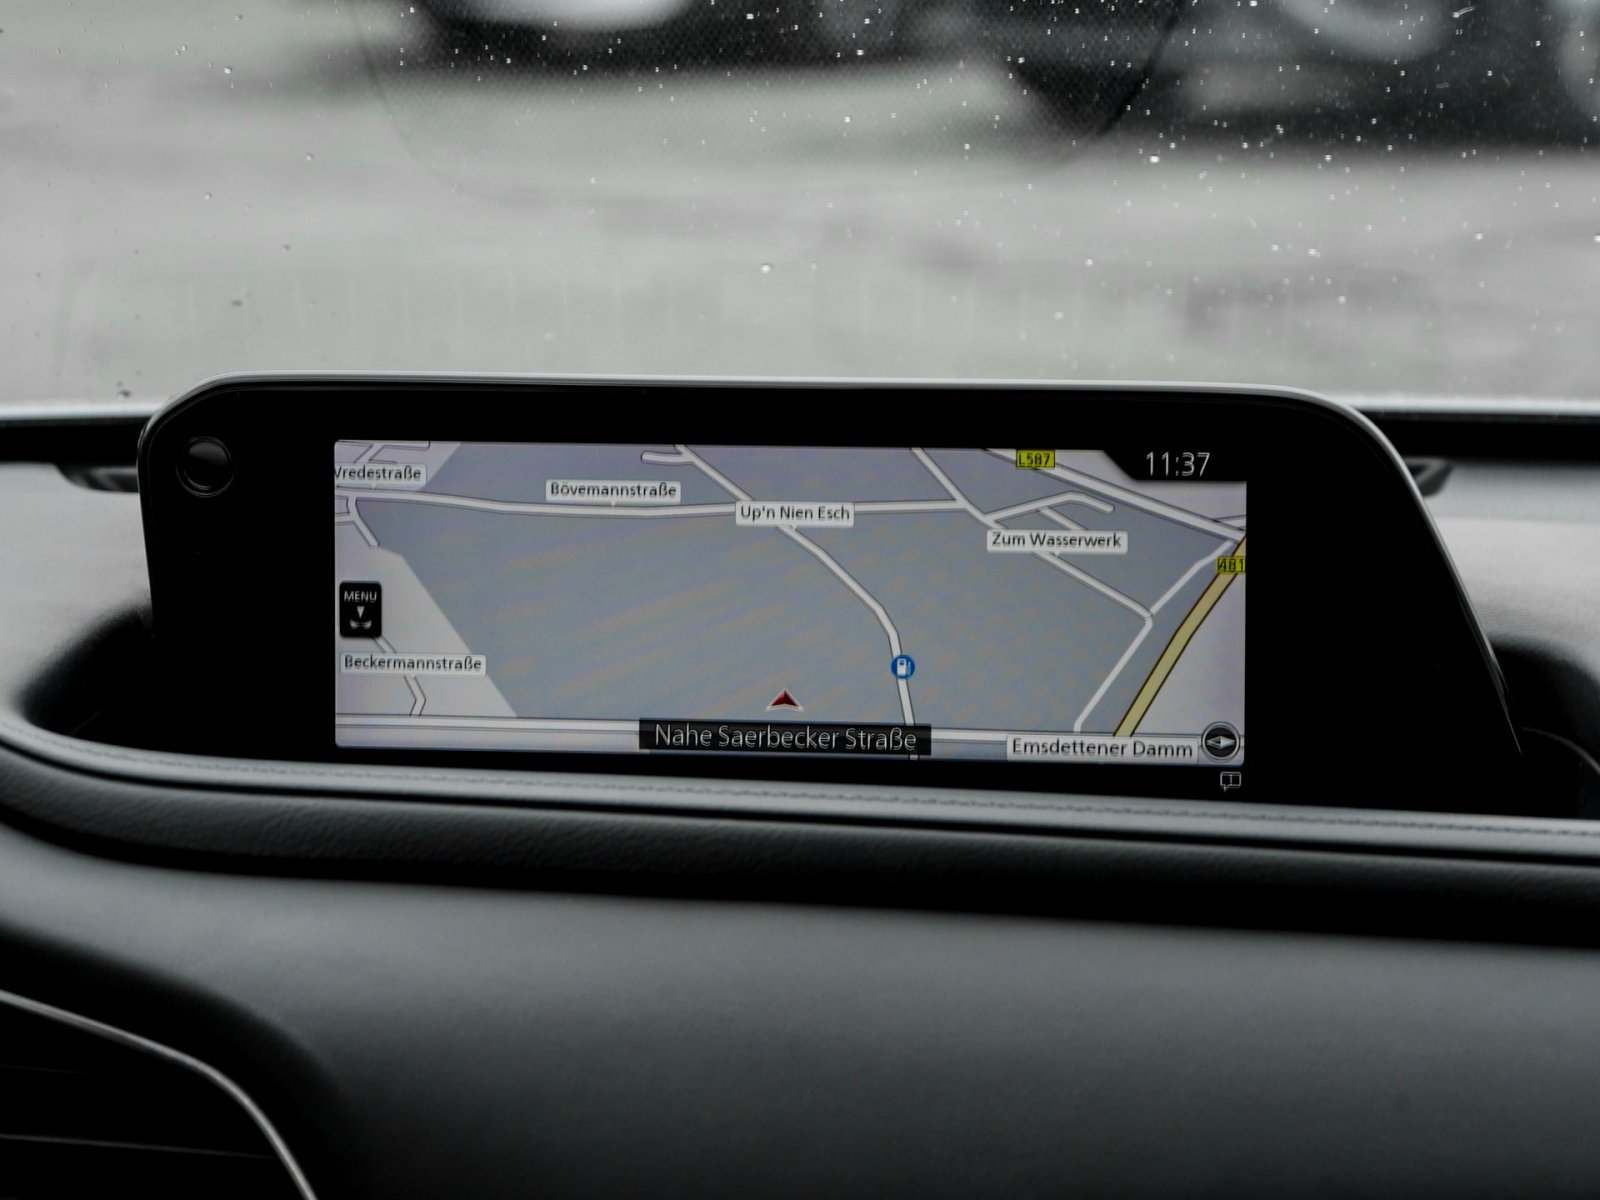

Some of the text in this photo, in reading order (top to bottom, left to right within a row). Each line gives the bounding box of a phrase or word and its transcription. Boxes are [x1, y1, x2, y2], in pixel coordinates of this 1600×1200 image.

[1018, 451, 1051, 467] L587
[1146, 451, 1211, 478] 11:37
[550, 482, 677, 498] Bövemannstraße
[740, 506, 850, 522] Up'n Nien Esch
[992, 532, 1121, 548] Zum Wasserwerk
[343, 590, 377, 602] MENU
[344, 655, 482, 671] Beckermannstraße
[655, 724, 917, 751] Nahe Saerbecker Straße
[1012, 738, 1193, 759] Emsdettener Damm
